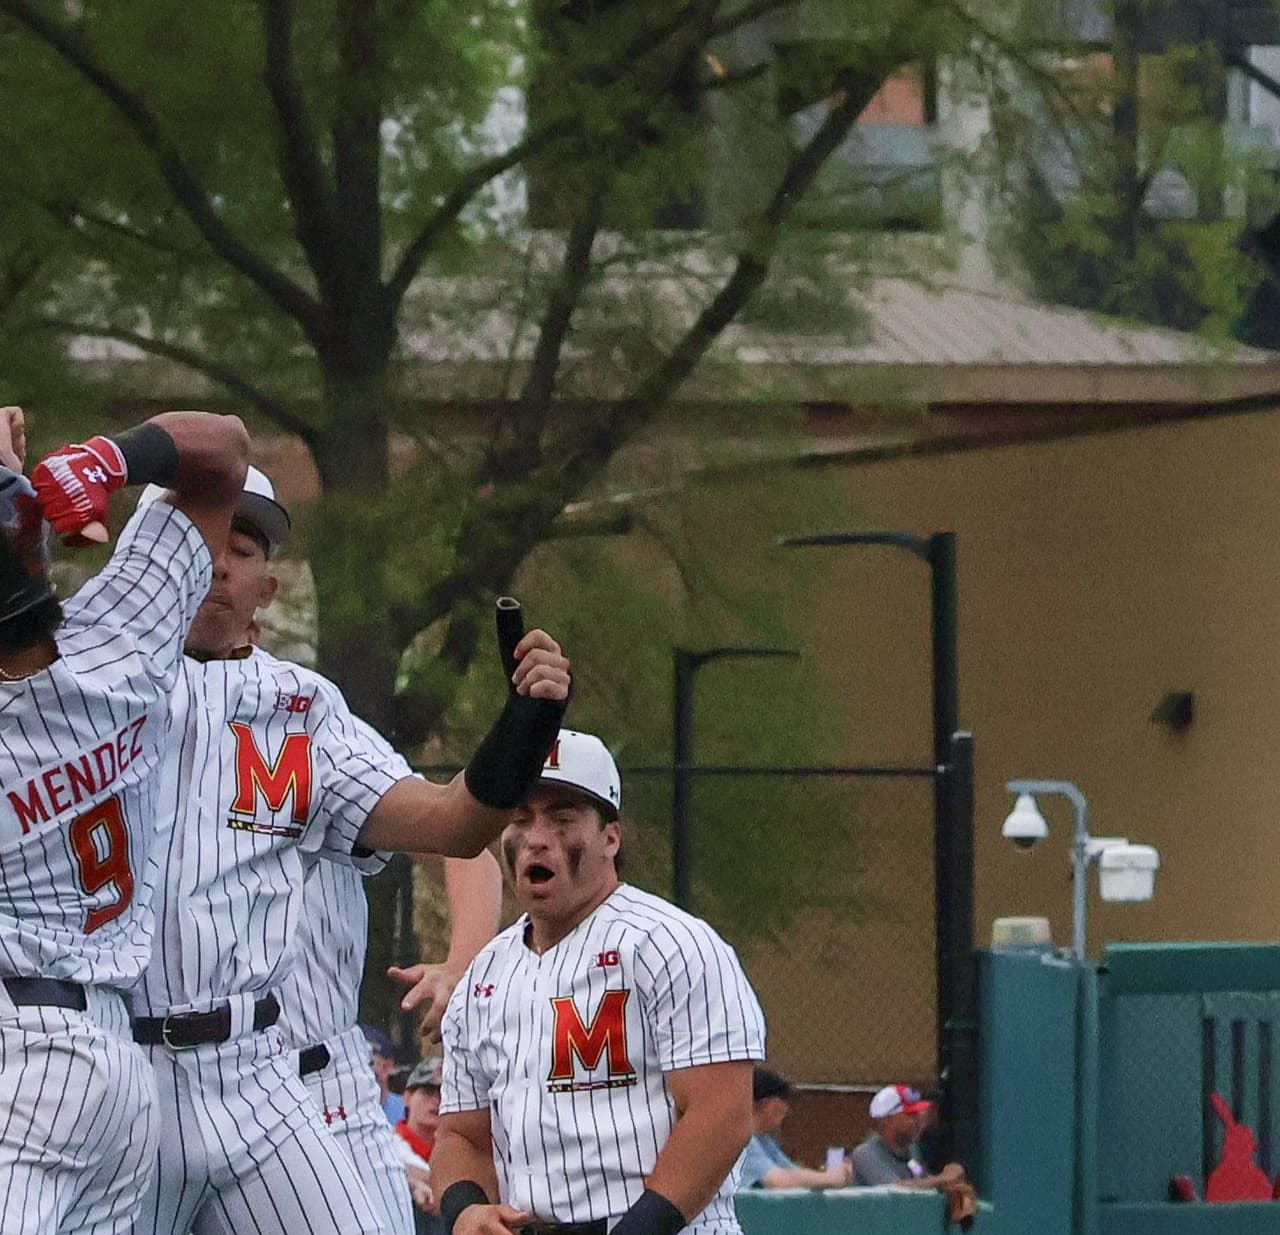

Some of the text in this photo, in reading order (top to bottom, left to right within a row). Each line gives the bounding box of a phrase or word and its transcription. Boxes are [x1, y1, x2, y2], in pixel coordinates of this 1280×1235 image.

[6, 713, 148, 835] MENDEZ
[228, 721, 312, 825] M
[69, 793, 135, 936] 9
[547, 989, 635, 1081] M
